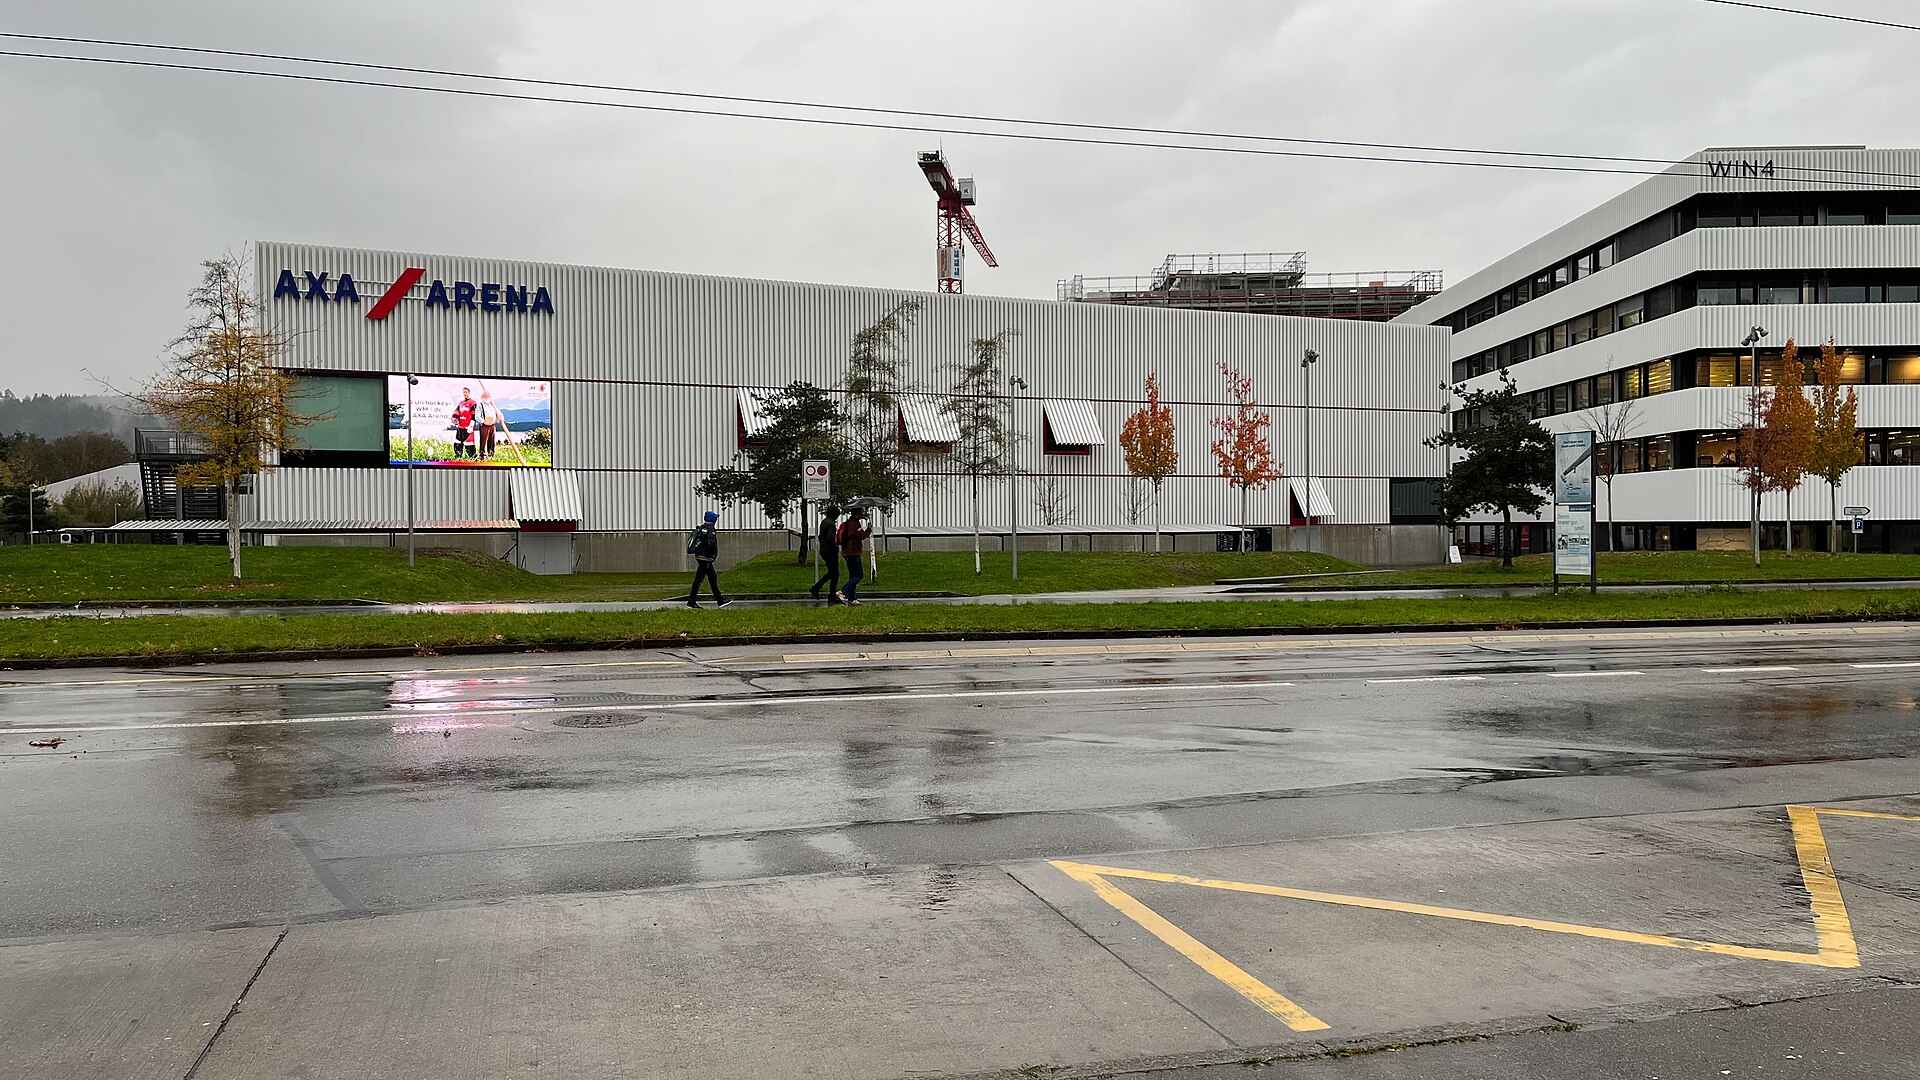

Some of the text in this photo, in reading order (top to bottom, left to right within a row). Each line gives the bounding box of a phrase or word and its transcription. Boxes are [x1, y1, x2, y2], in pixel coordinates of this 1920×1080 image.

[1708, 159, 1775, 177] WIN4
[274, 269, 555, 314] AXA ARENA
[1856, 521, 1861, 529] P
